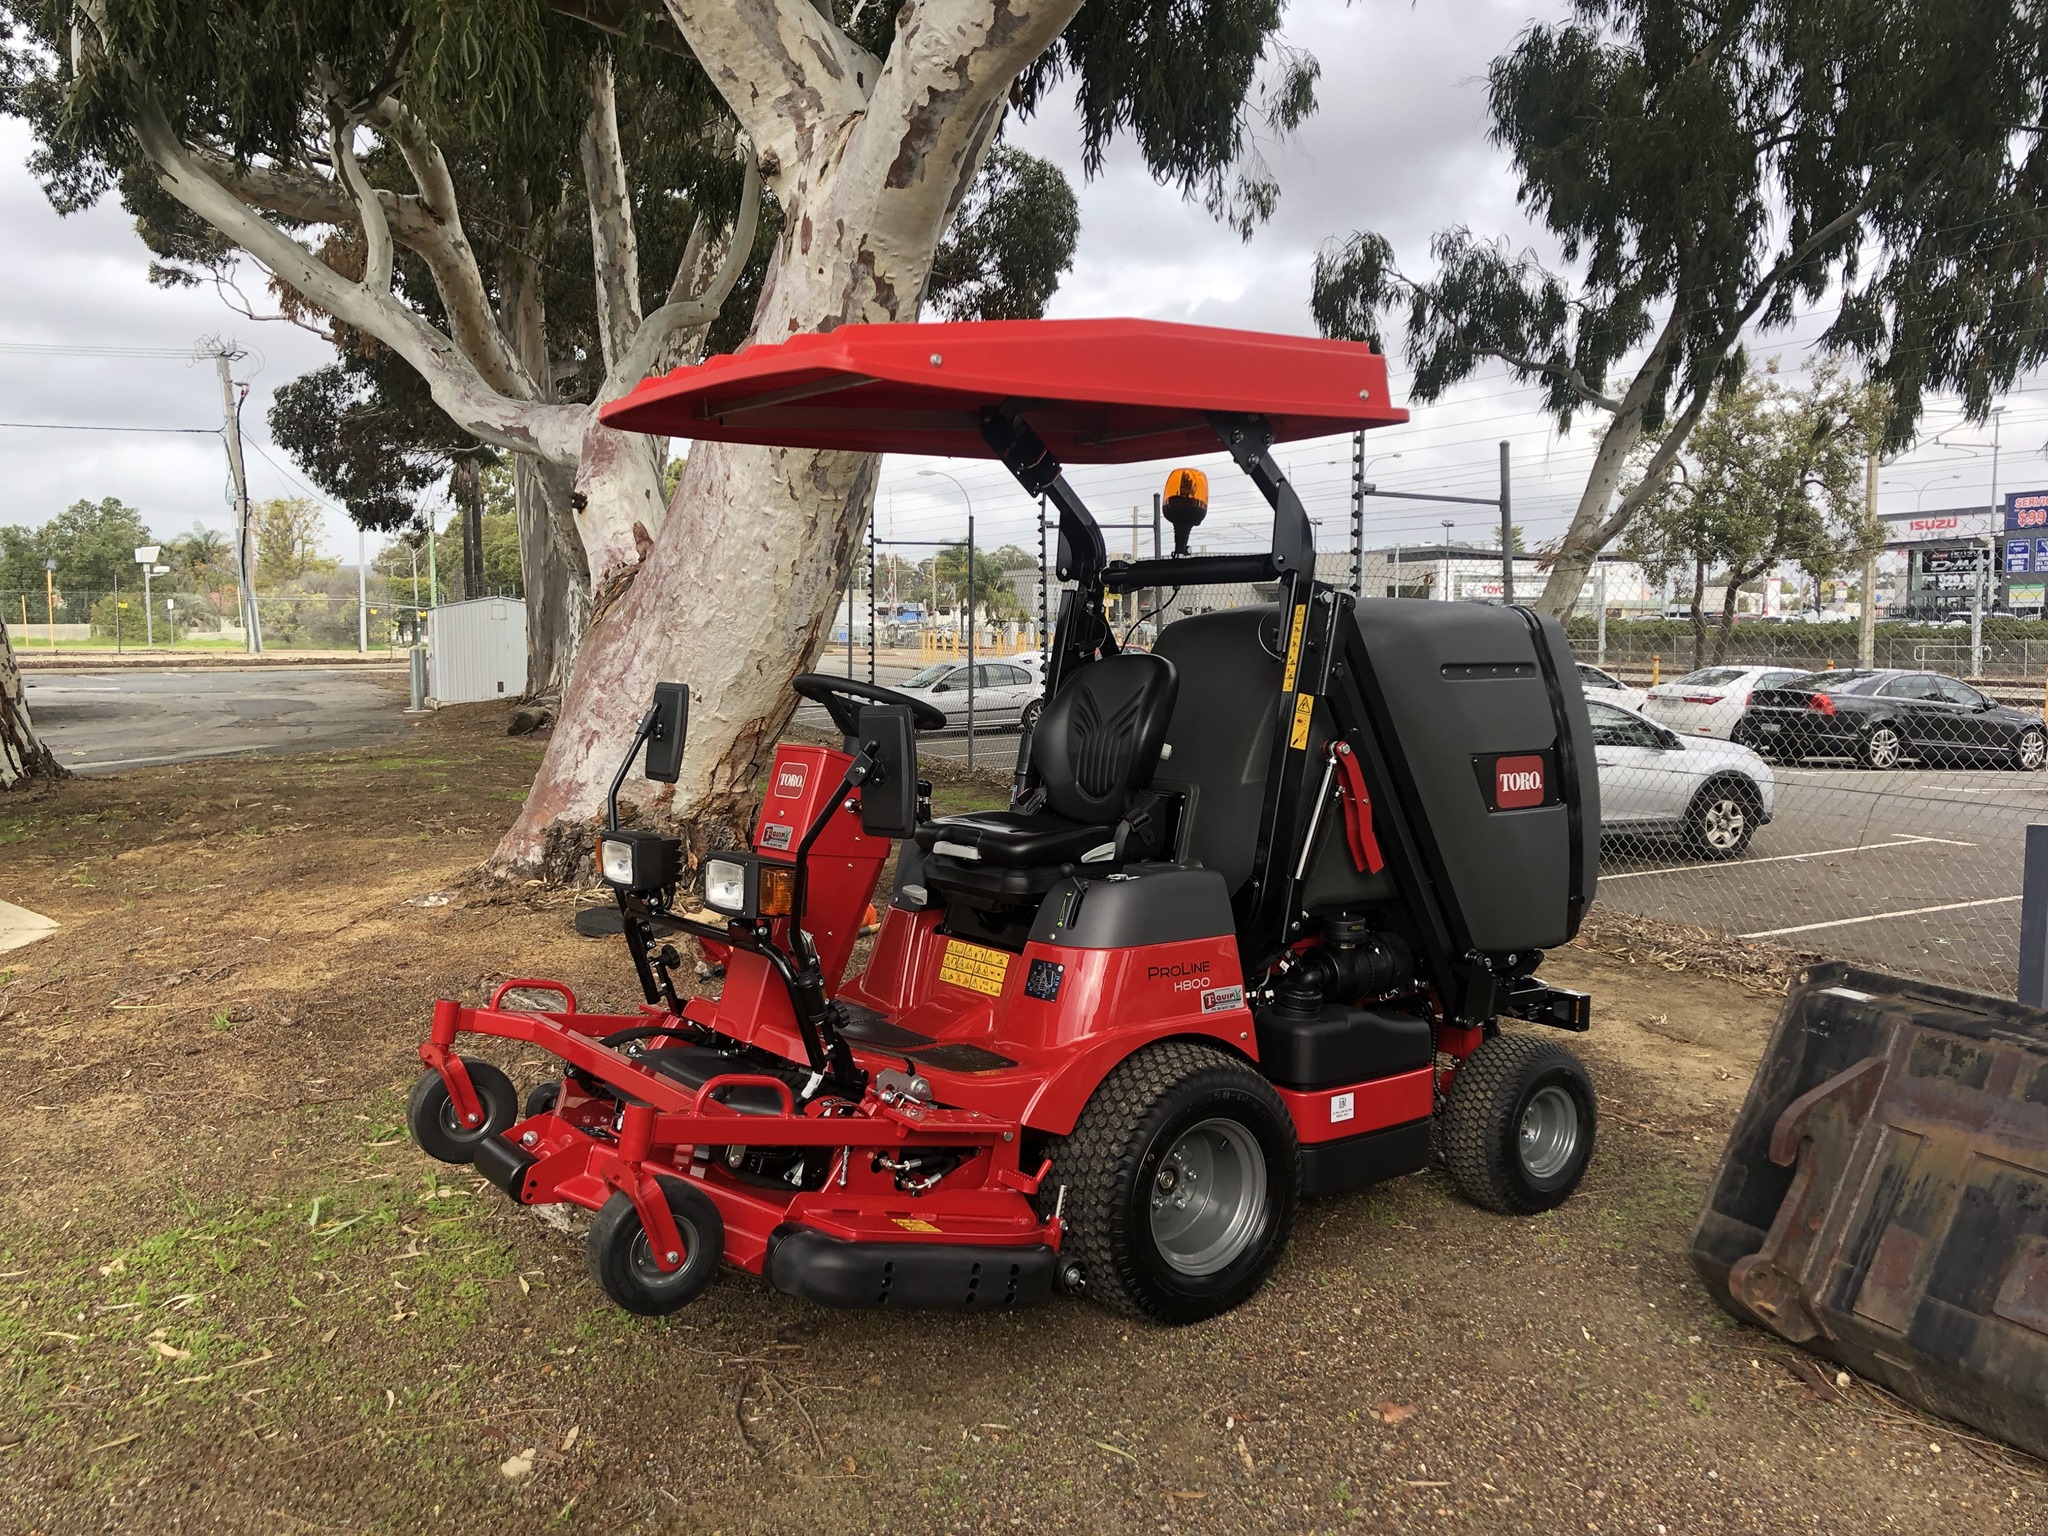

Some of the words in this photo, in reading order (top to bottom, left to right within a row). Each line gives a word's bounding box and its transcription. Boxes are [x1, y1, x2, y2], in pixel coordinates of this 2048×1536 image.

[1909, 518, 1958, 531] ISUZU
[2018, 509, 2047, 527] $99
[1482, 586, 1517, 595] TOYO
[780, 773, 803, 788] TORO
[1500, 771, 1541, 792] TORO
[1174, 977, 1210, 992] H800
